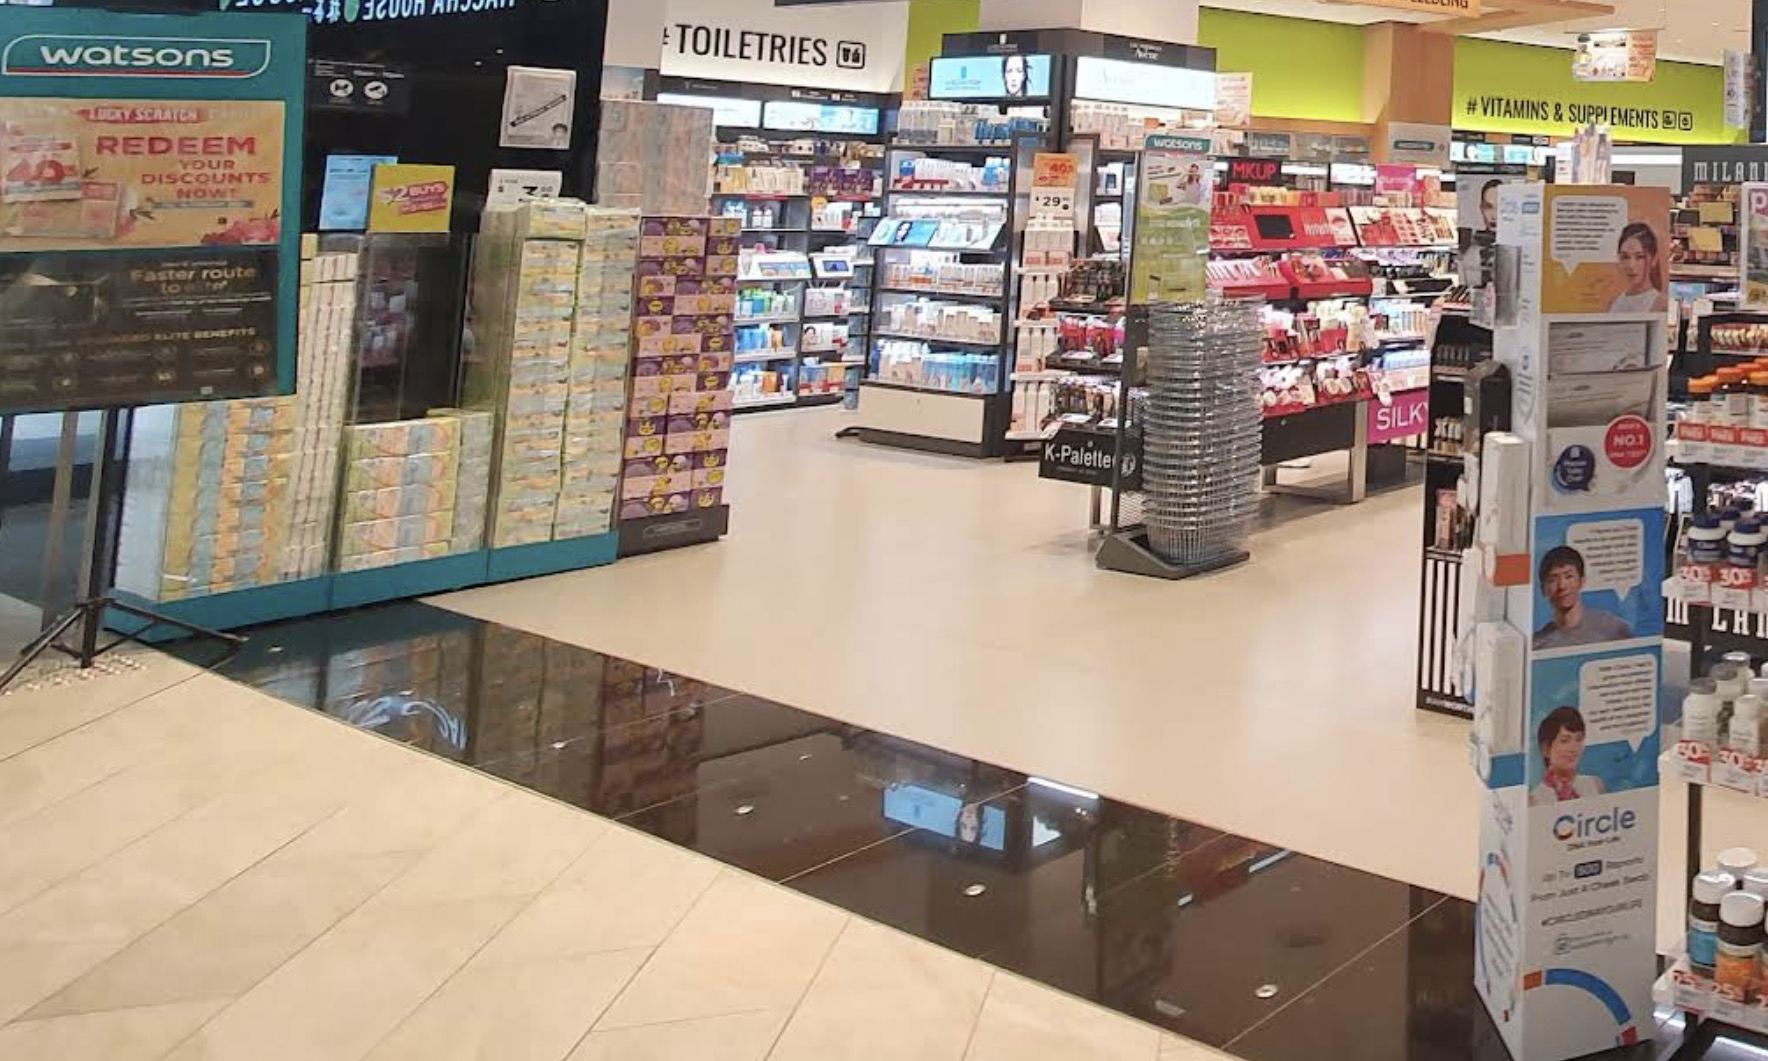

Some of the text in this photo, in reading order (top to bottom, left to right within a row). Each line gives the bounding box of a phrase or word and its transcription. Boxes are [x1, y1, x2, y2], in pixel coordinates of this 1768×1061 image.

[40, 45, 234, 67] watsons
[1553, 102, 1563, 122] &
[96, 136, 256, 155] REDEEM
[1154, 138, 1203, 150] watsons
[180, 159, 235, 170] YOUR
[1233, 160, 1276, 180] MKUP
[1694, 161, 1768, 182] MILANI
[141, 172, 271, 184] DISCOUNTS
[130, 266, 257, 283] Faster route
[1044, 442, 1112, 469] K-Palette
[1553, 807, 1636, 840] Circle
